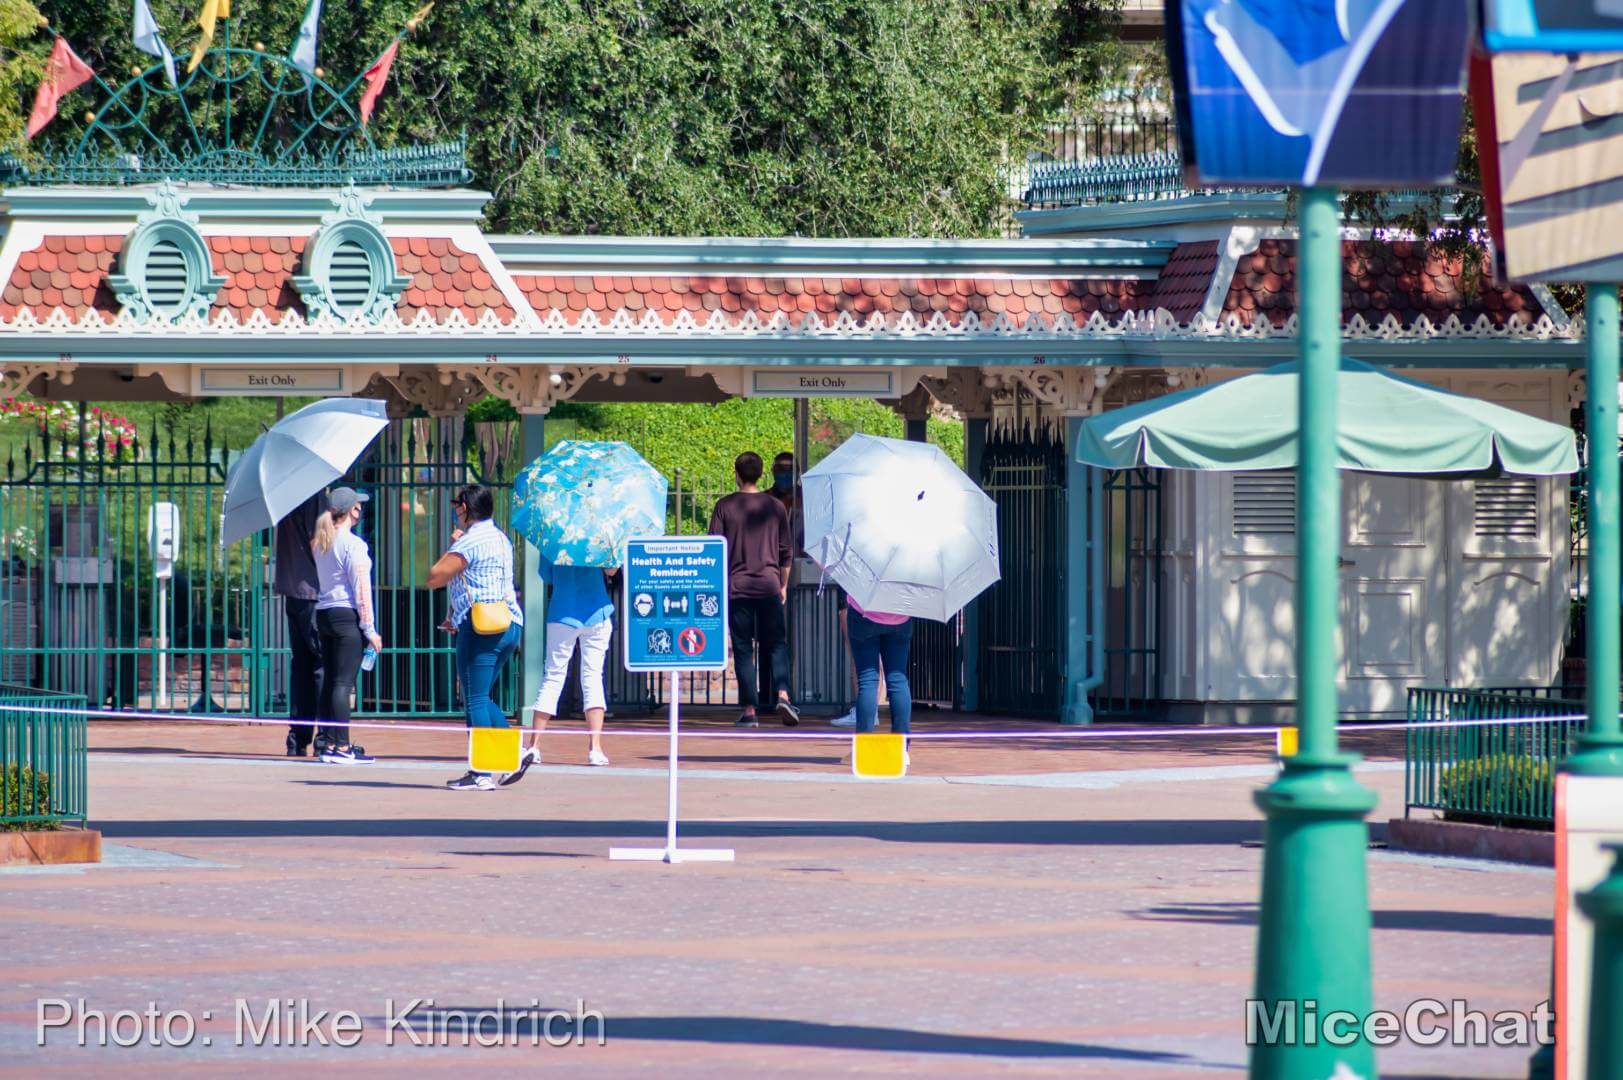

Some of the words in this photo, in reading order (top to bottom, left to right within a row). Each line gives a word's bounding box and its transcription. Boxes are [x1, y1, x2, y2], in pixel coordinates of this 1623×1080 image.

[248, 375, 268, 385] Exit
[271, 375, 297, 387] Only
[800, 377, 818, 387] Exit
[822, 377, 847, 389] Only
[647, 544, 678, 552] Important
[632, 557, 662, 566] Health
[665, 557, 684, 566] And
[686, 556, 717, 567] Safety
[650, 568, 698, 577] Reminders
